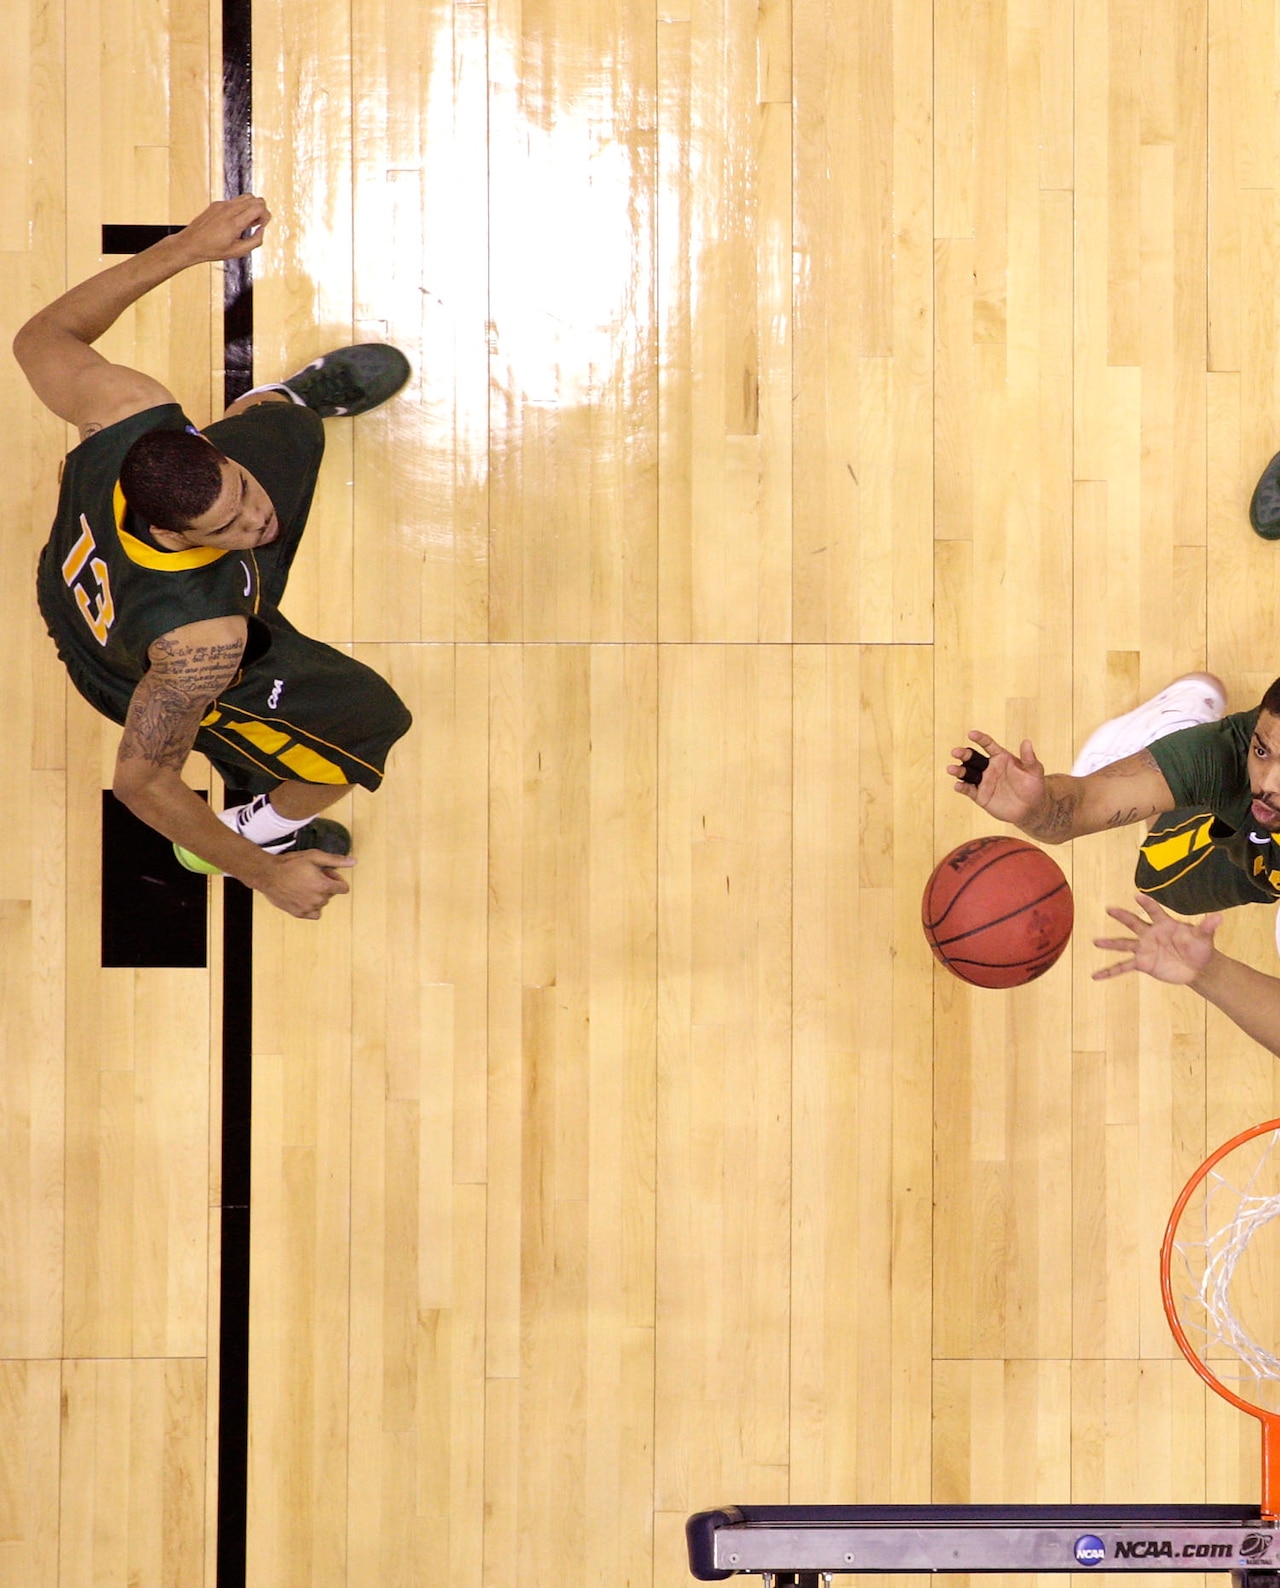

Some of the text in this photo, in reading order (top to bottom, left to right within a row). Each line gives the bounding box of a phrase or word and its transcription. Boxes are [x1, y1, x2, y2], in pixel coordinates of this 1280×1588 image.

[62, 513, 115, 647] 13
[1076, 1541, 1233, 1560] NCAA NCAA.com
